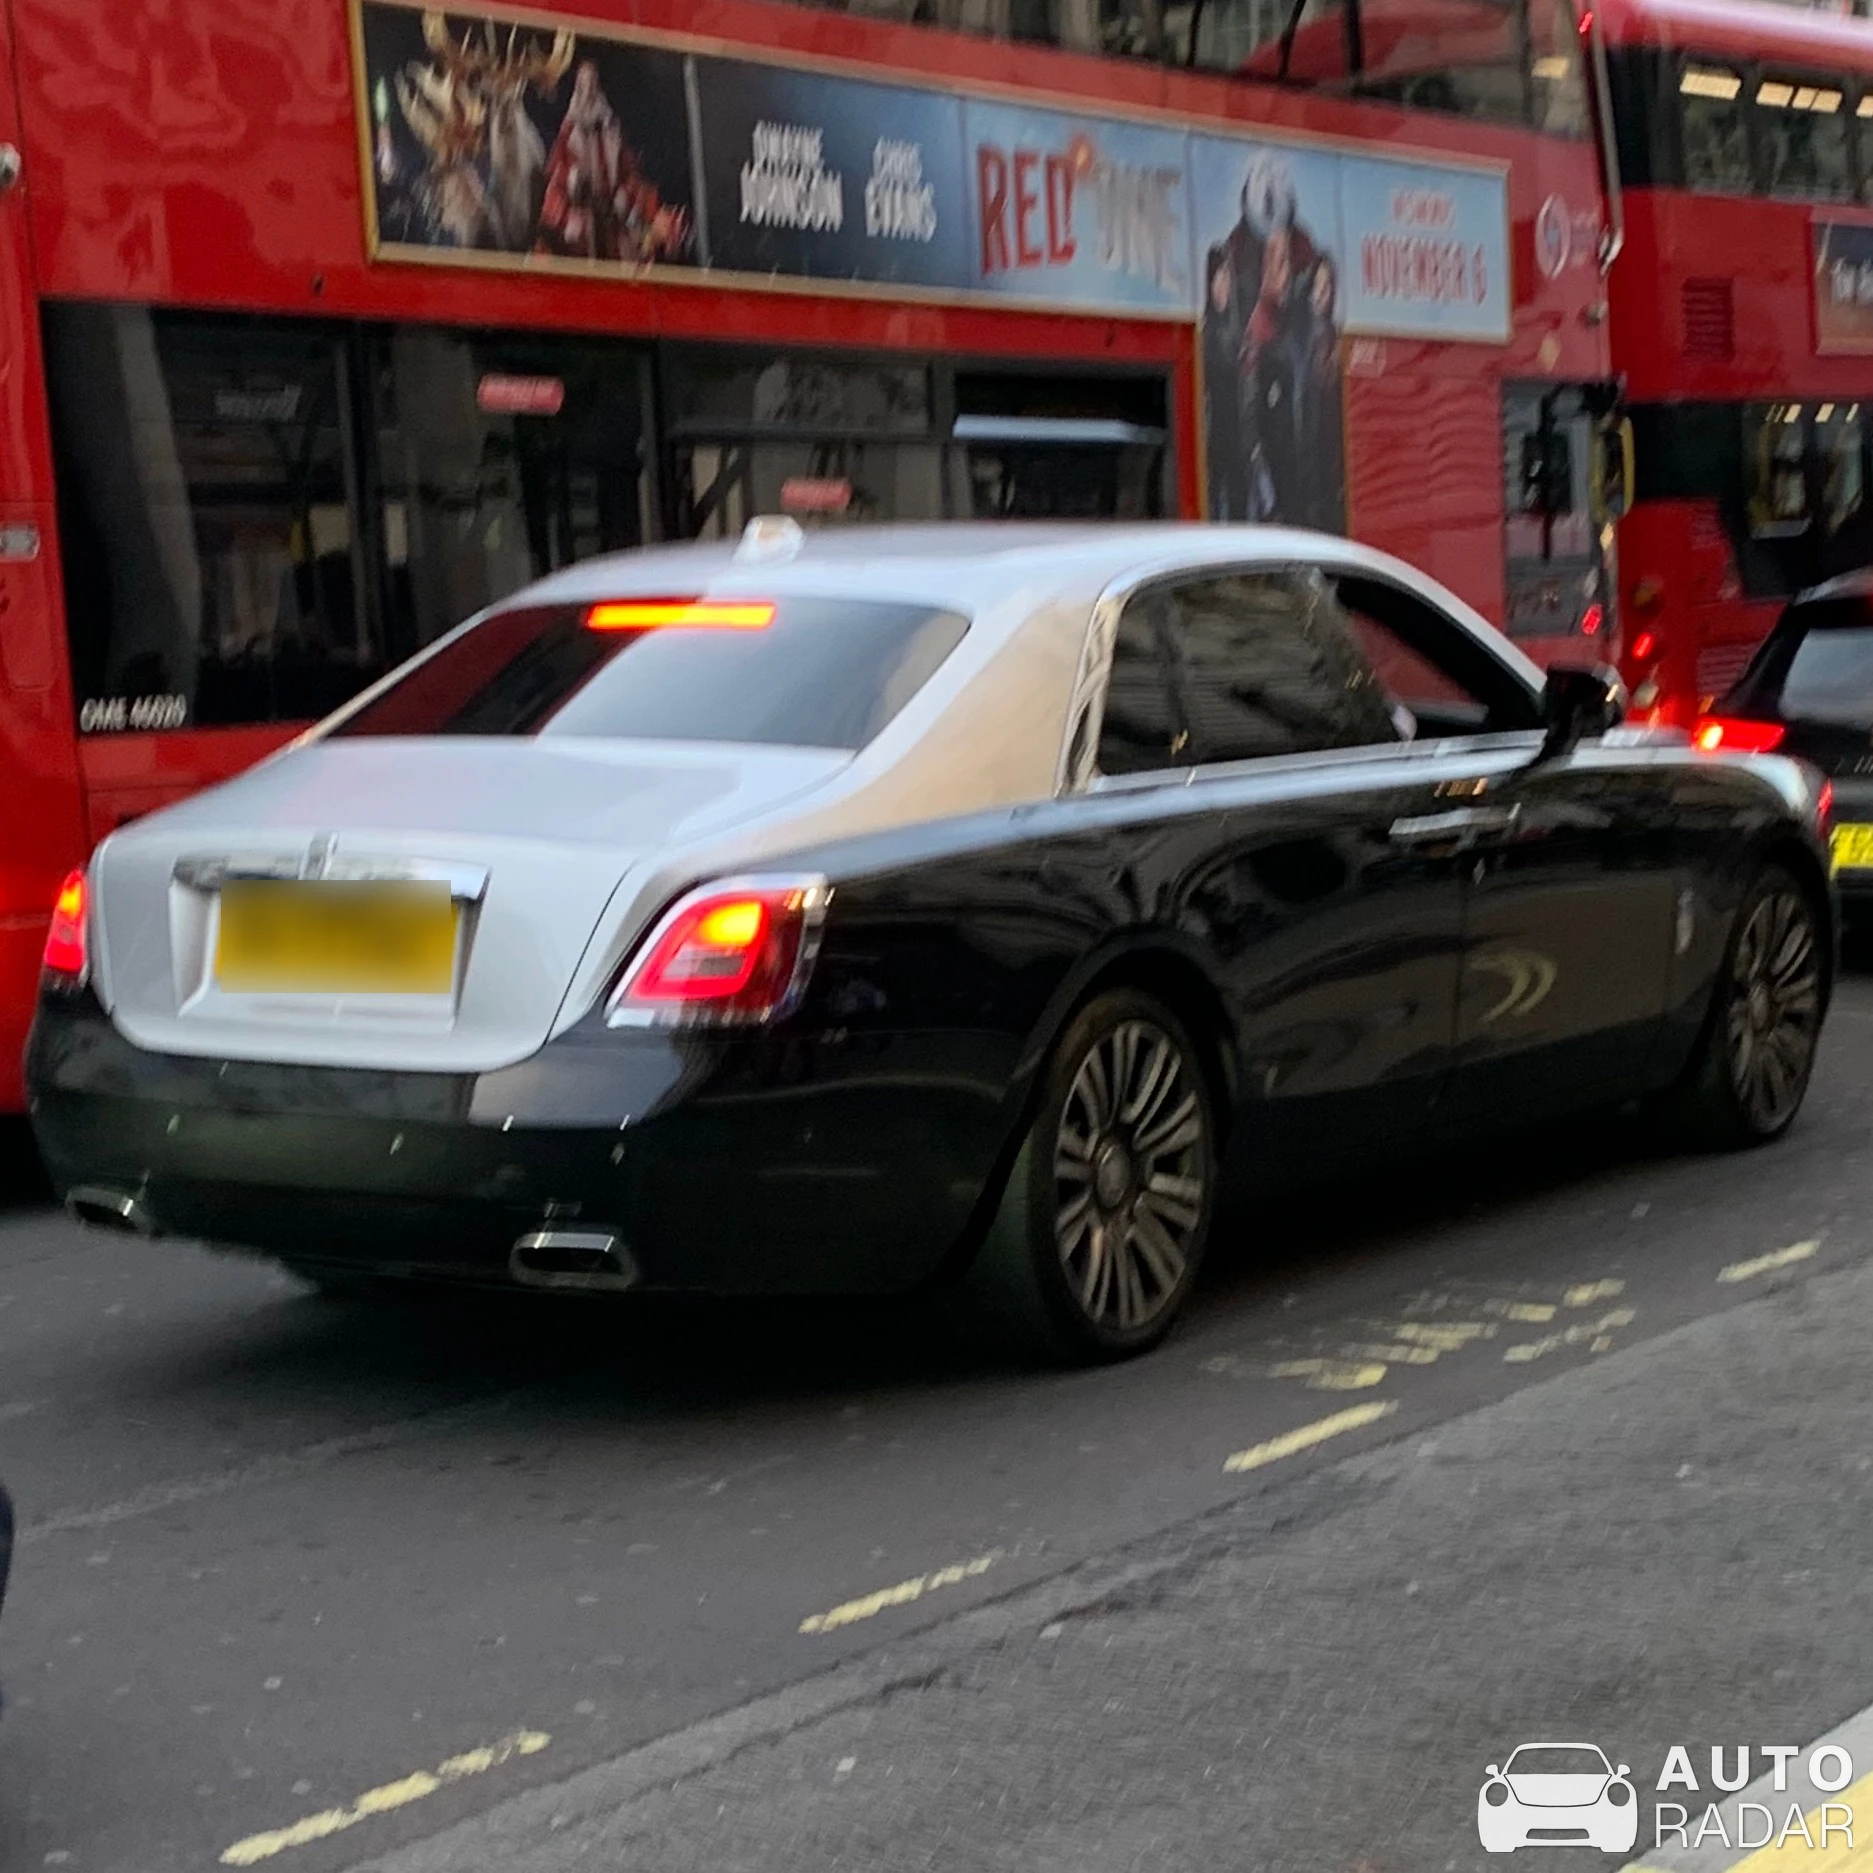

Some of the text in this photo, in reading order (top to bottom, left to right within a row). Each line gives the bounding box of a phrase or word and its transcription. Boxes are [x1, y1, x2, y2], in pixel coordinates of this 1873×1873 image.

[740, 160, 843, 232] JOHNSON
[977, 144, 1078, 278] RED
[1362, 232, 1467, 302] NOVEMBER
